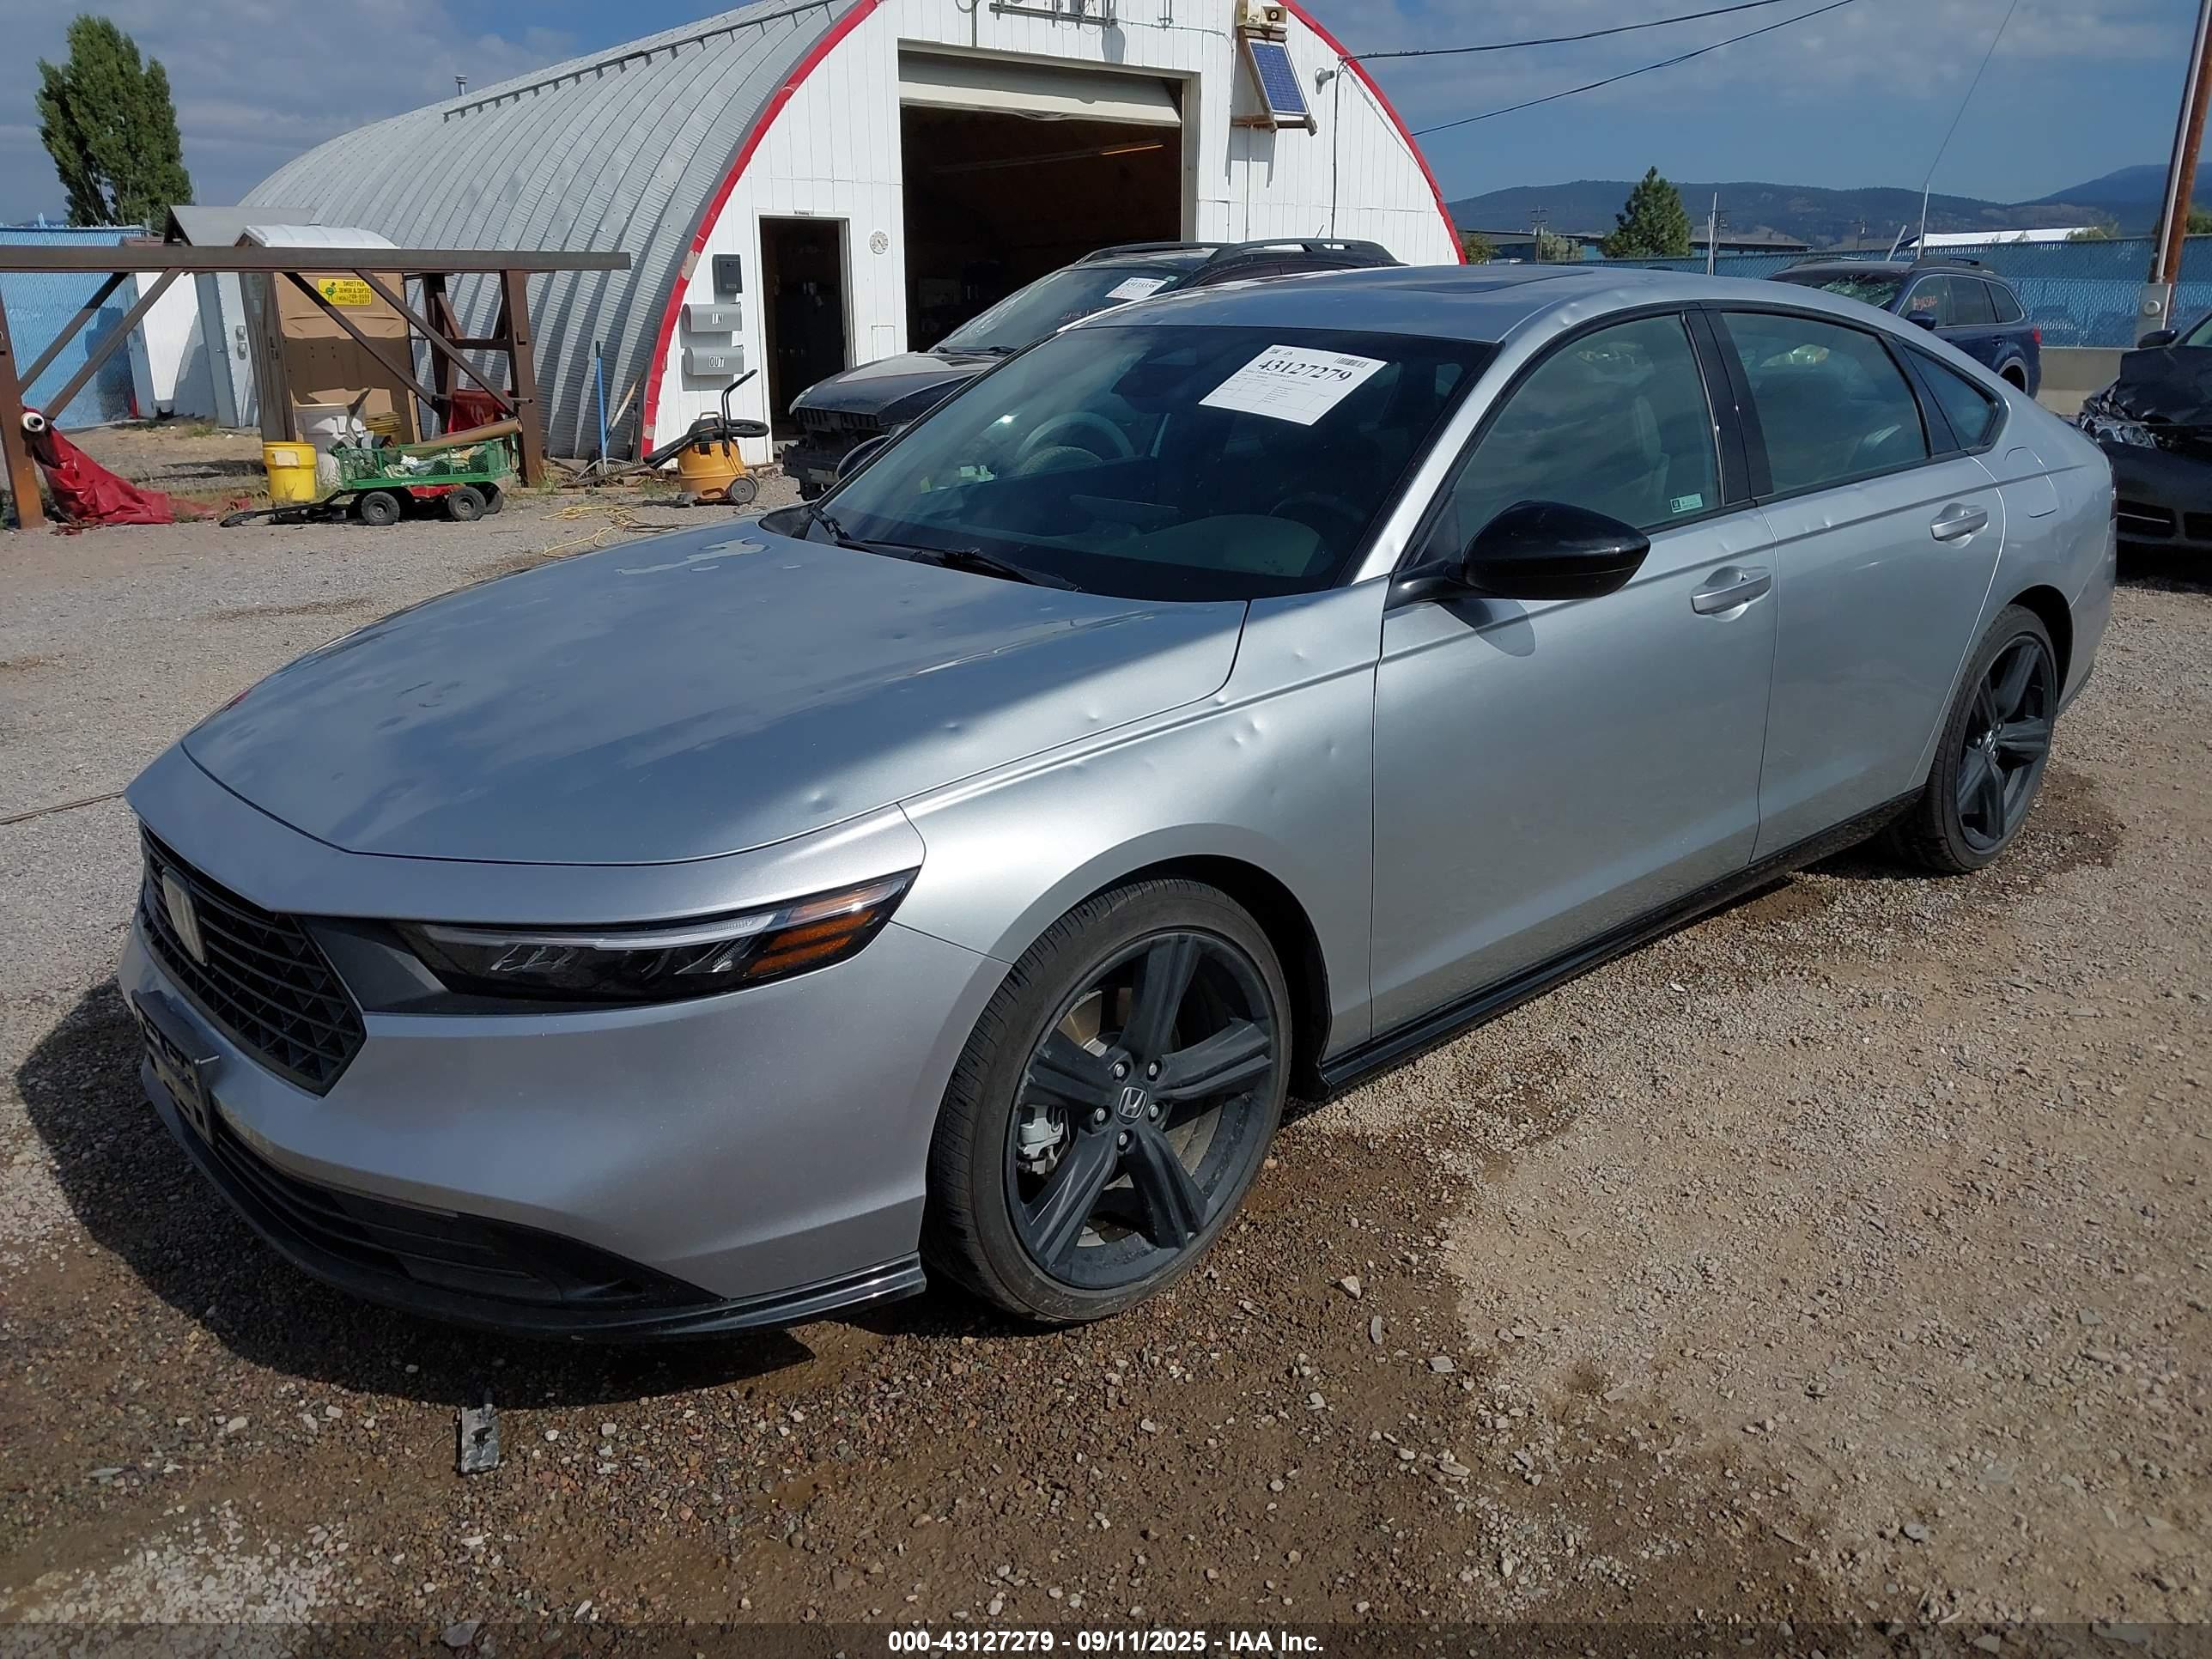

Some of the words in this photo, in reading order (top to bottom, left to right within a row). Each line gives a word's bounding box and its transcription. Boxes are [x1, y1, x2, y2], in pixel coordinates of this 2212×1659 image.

[713, 313, 723, 324] IN
[709, 356, 725, 367] OUT
[1257, 359, 1353, 382] 43127279
